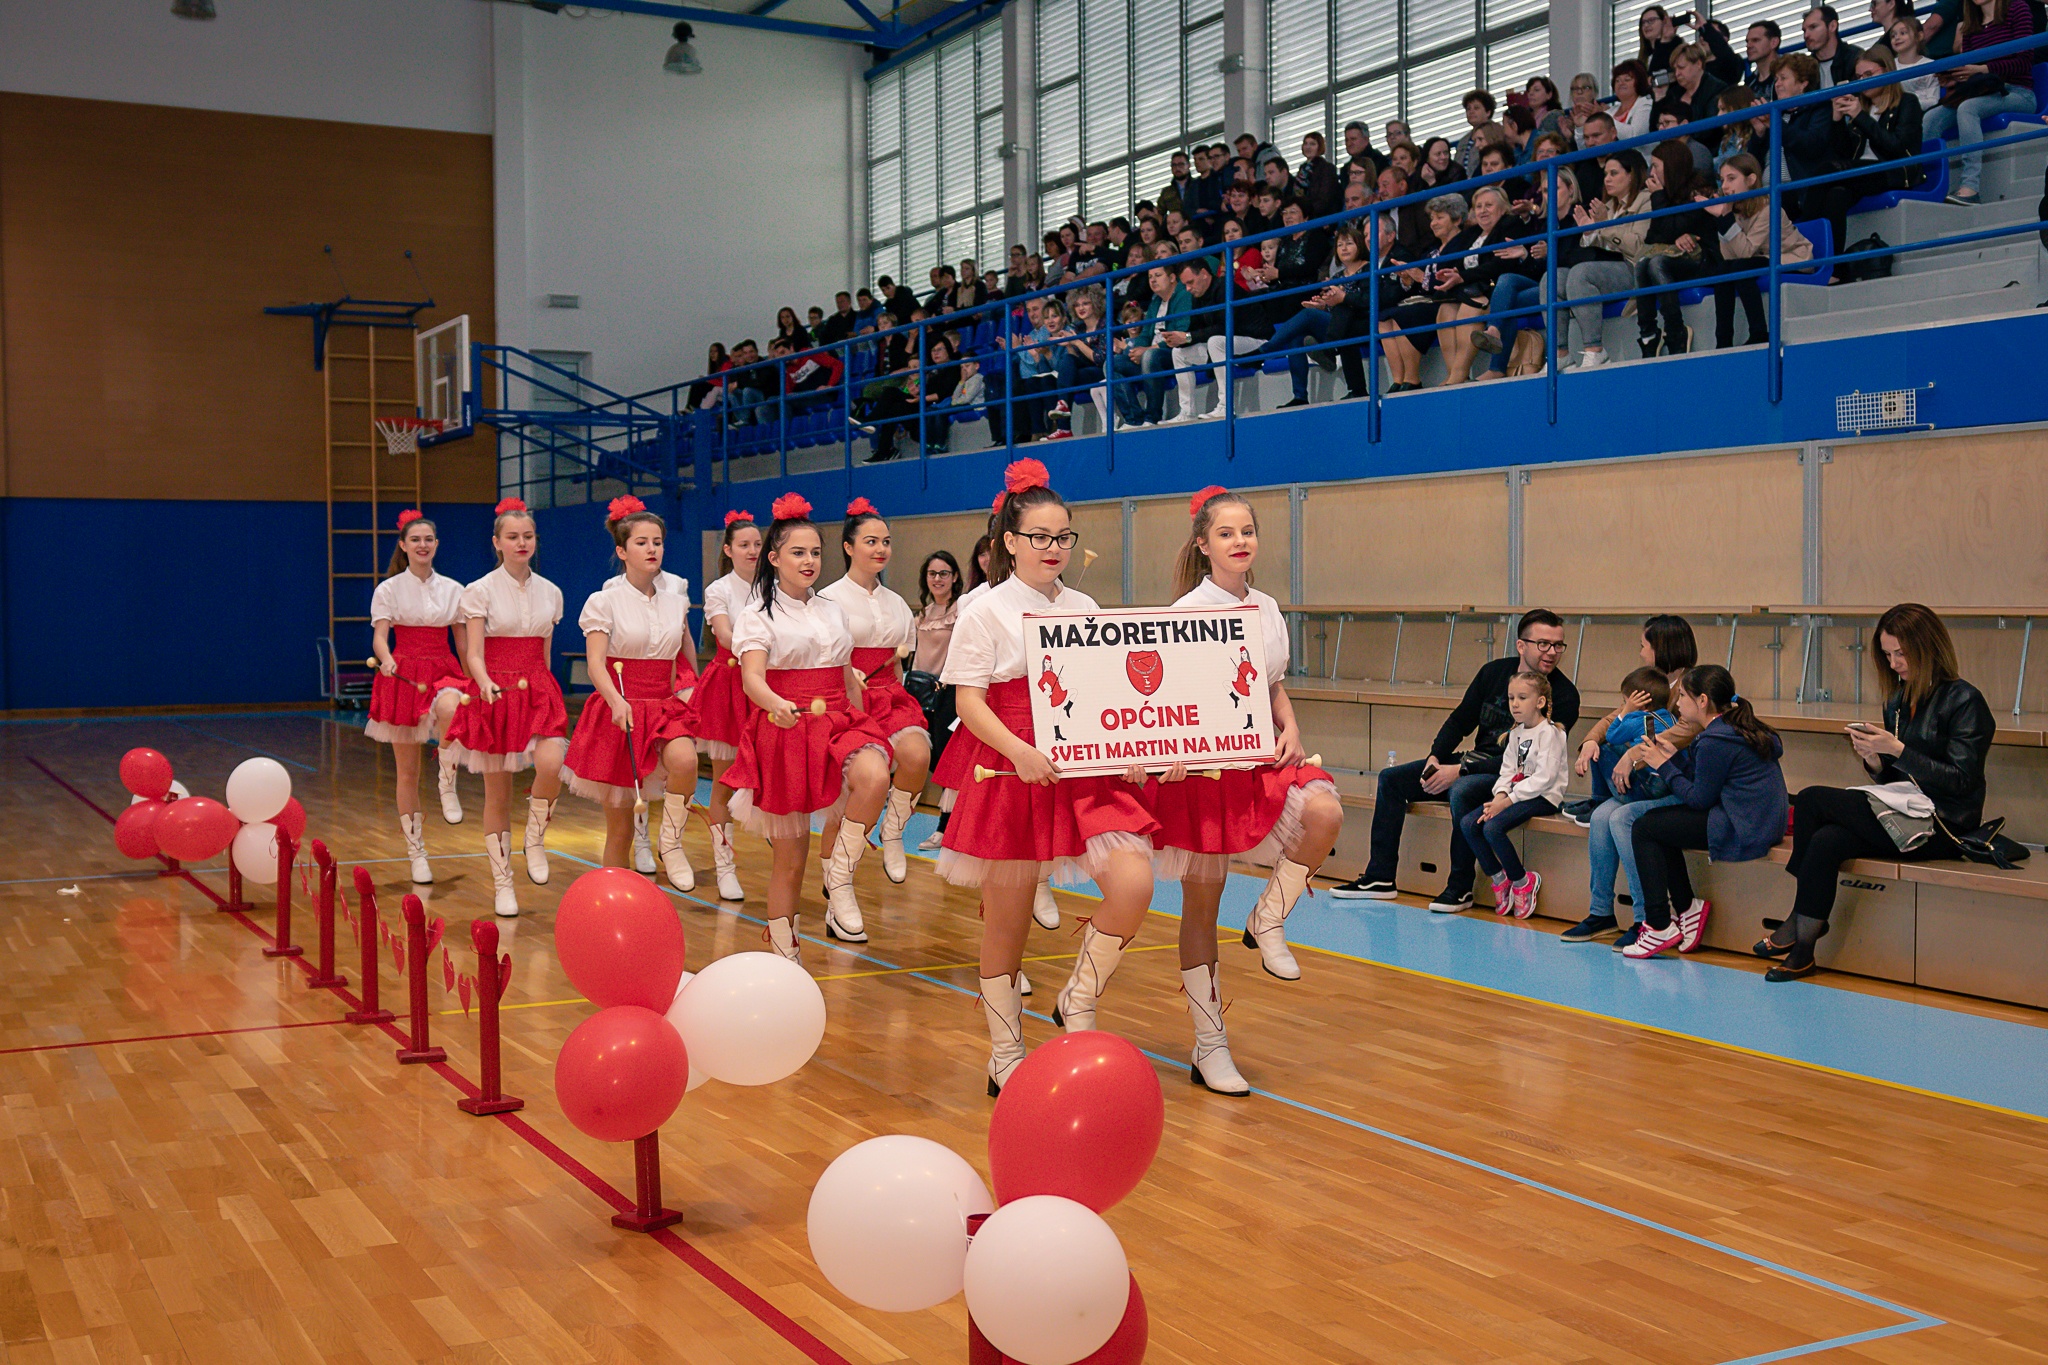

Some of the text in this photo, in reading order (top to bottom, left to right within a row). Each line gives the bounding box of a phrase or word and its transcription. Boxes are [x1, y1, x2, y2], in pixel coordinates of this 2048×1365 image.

[1039, 616, 1244, 648] MAŽORETKINJE
[1100, 700, 1199, 730] OPĆINE
[1050, 733, 1262, 764] SVETI MARTIN NA MURI
[1839, 879, 1886, 891] elan
